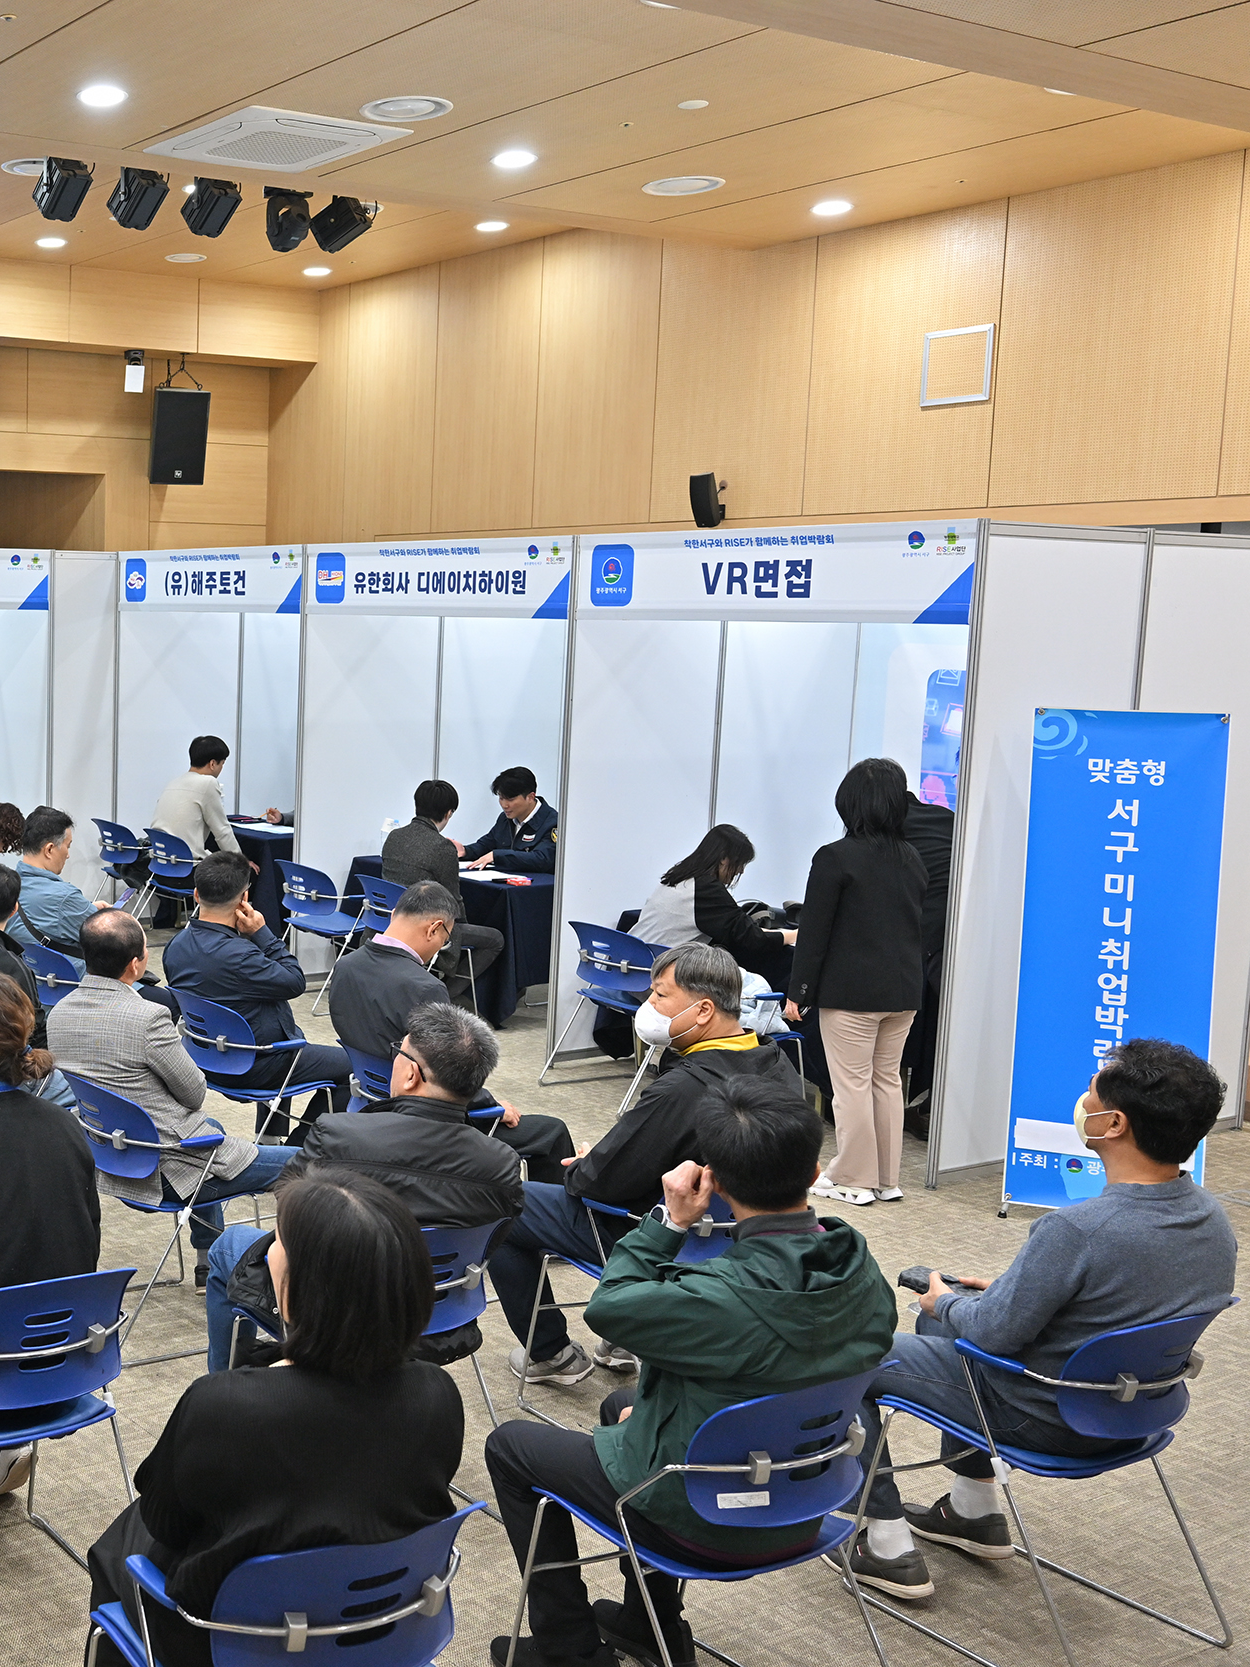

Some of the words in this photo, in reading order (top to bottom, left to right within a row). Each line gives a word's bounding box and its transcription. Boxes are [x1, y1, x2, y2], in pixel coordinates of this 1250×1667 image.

[379, 548, 406, 557] 착한서구와
[406, 548, 427, 556] RISE가
[427, 548, 450, 556] 함께하는
[450, 546, 481, 556] 취업박람회
[683, 538, 723, 549] 착한서구와
[724, 537, 753, 548] RISE가
[755, 535, 789, 547] 함께하는
[790, 534, 835, 546] 취업박람회
[164, 570, 246, 596] (유)해주토건
[354, 571, 410, 595] 유한회사
[417, 570, 527, 595] 디에이치하이원
[701, 558, 813, 599] VR면접
[1087, 758, 1166, 787] 맞춤형
[1104, 798, 1140, 863] 서구
[1093, 873, 1135, 1074] 미니취업박
[1019, 1152, 1047, 1168] 주최
